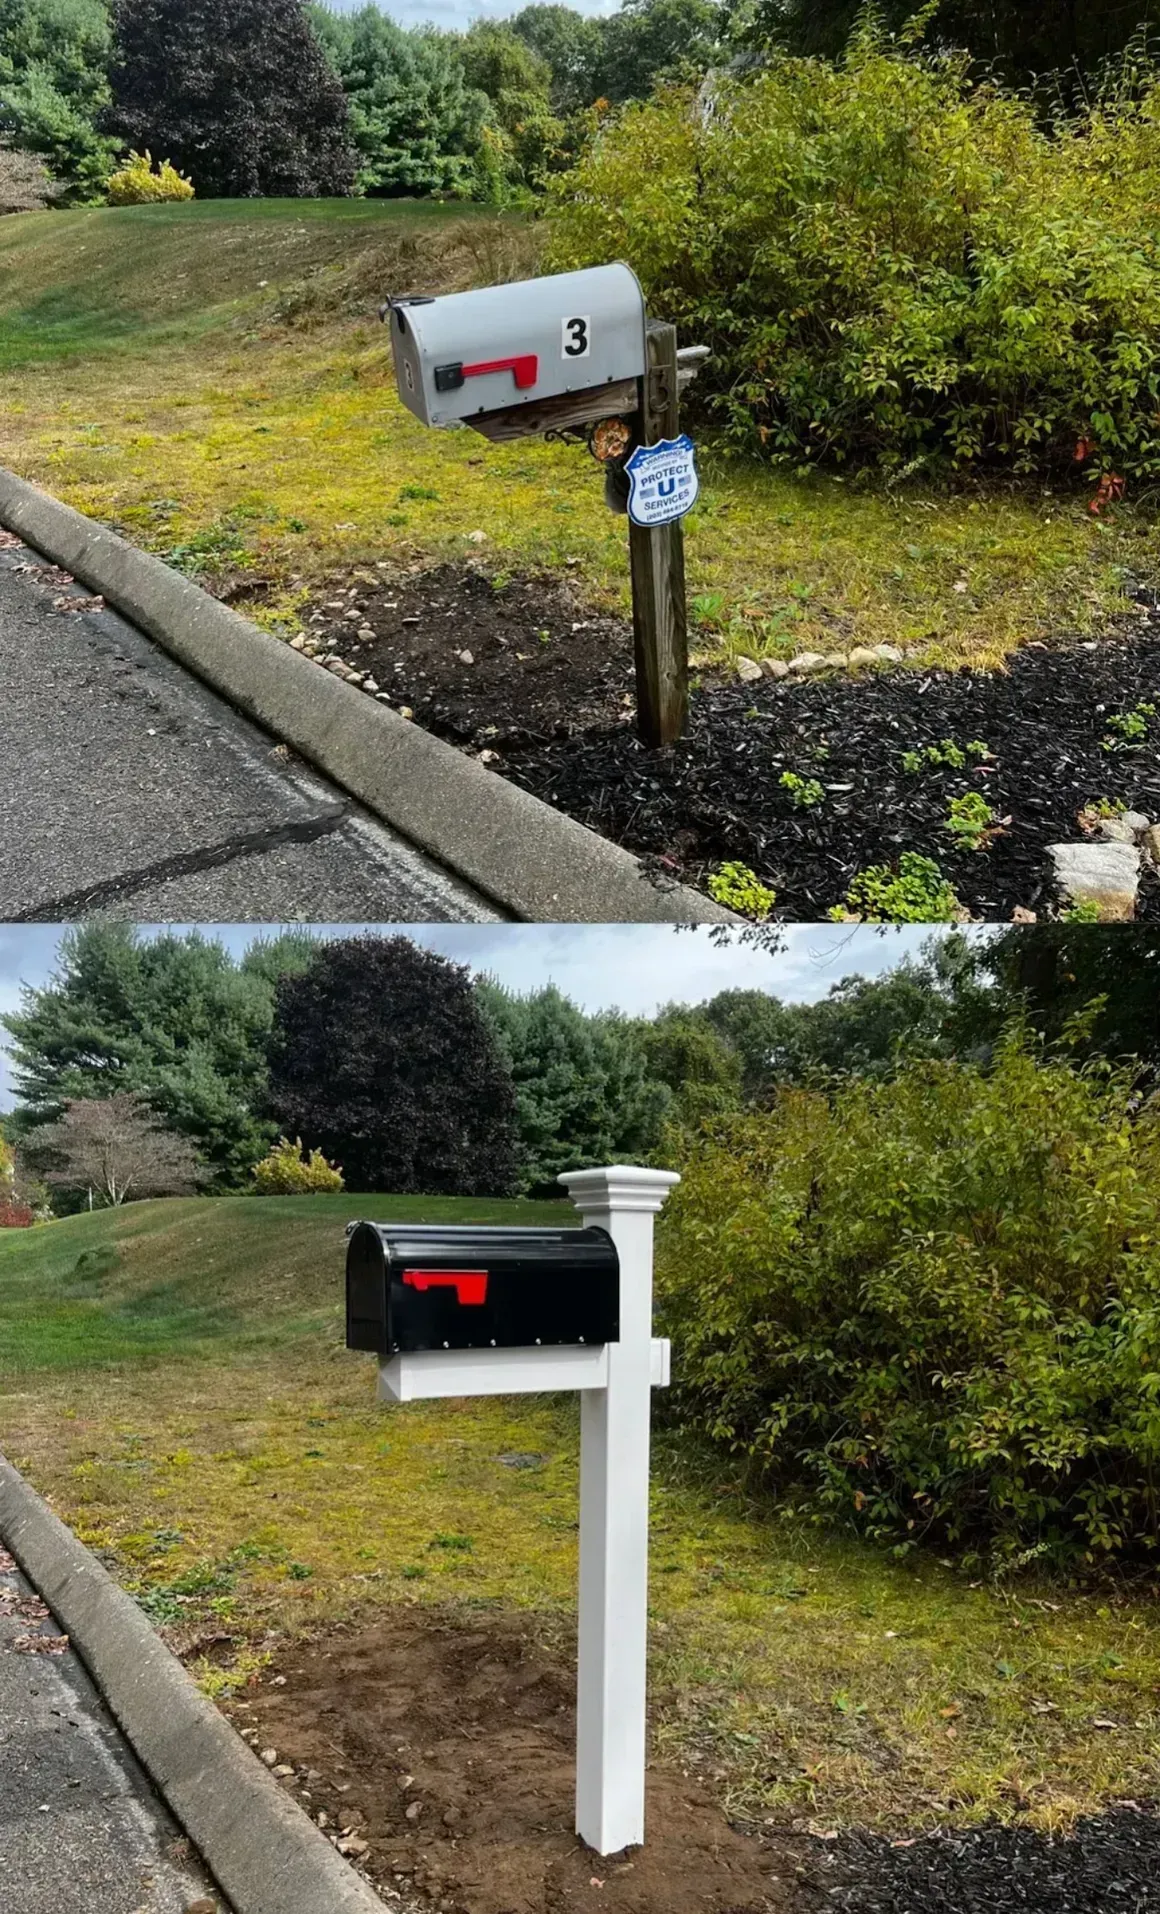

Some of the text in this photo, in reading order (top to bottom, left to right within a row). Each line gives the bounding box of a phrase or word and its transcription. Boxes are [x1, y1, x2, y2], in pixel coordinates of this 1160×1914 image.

[565, 318, 588, 356] 3
[640, 464, 689, 487] PROTECT
[657, 477, 675, 497] U
[644, 488, 690, 511] SERVICES
